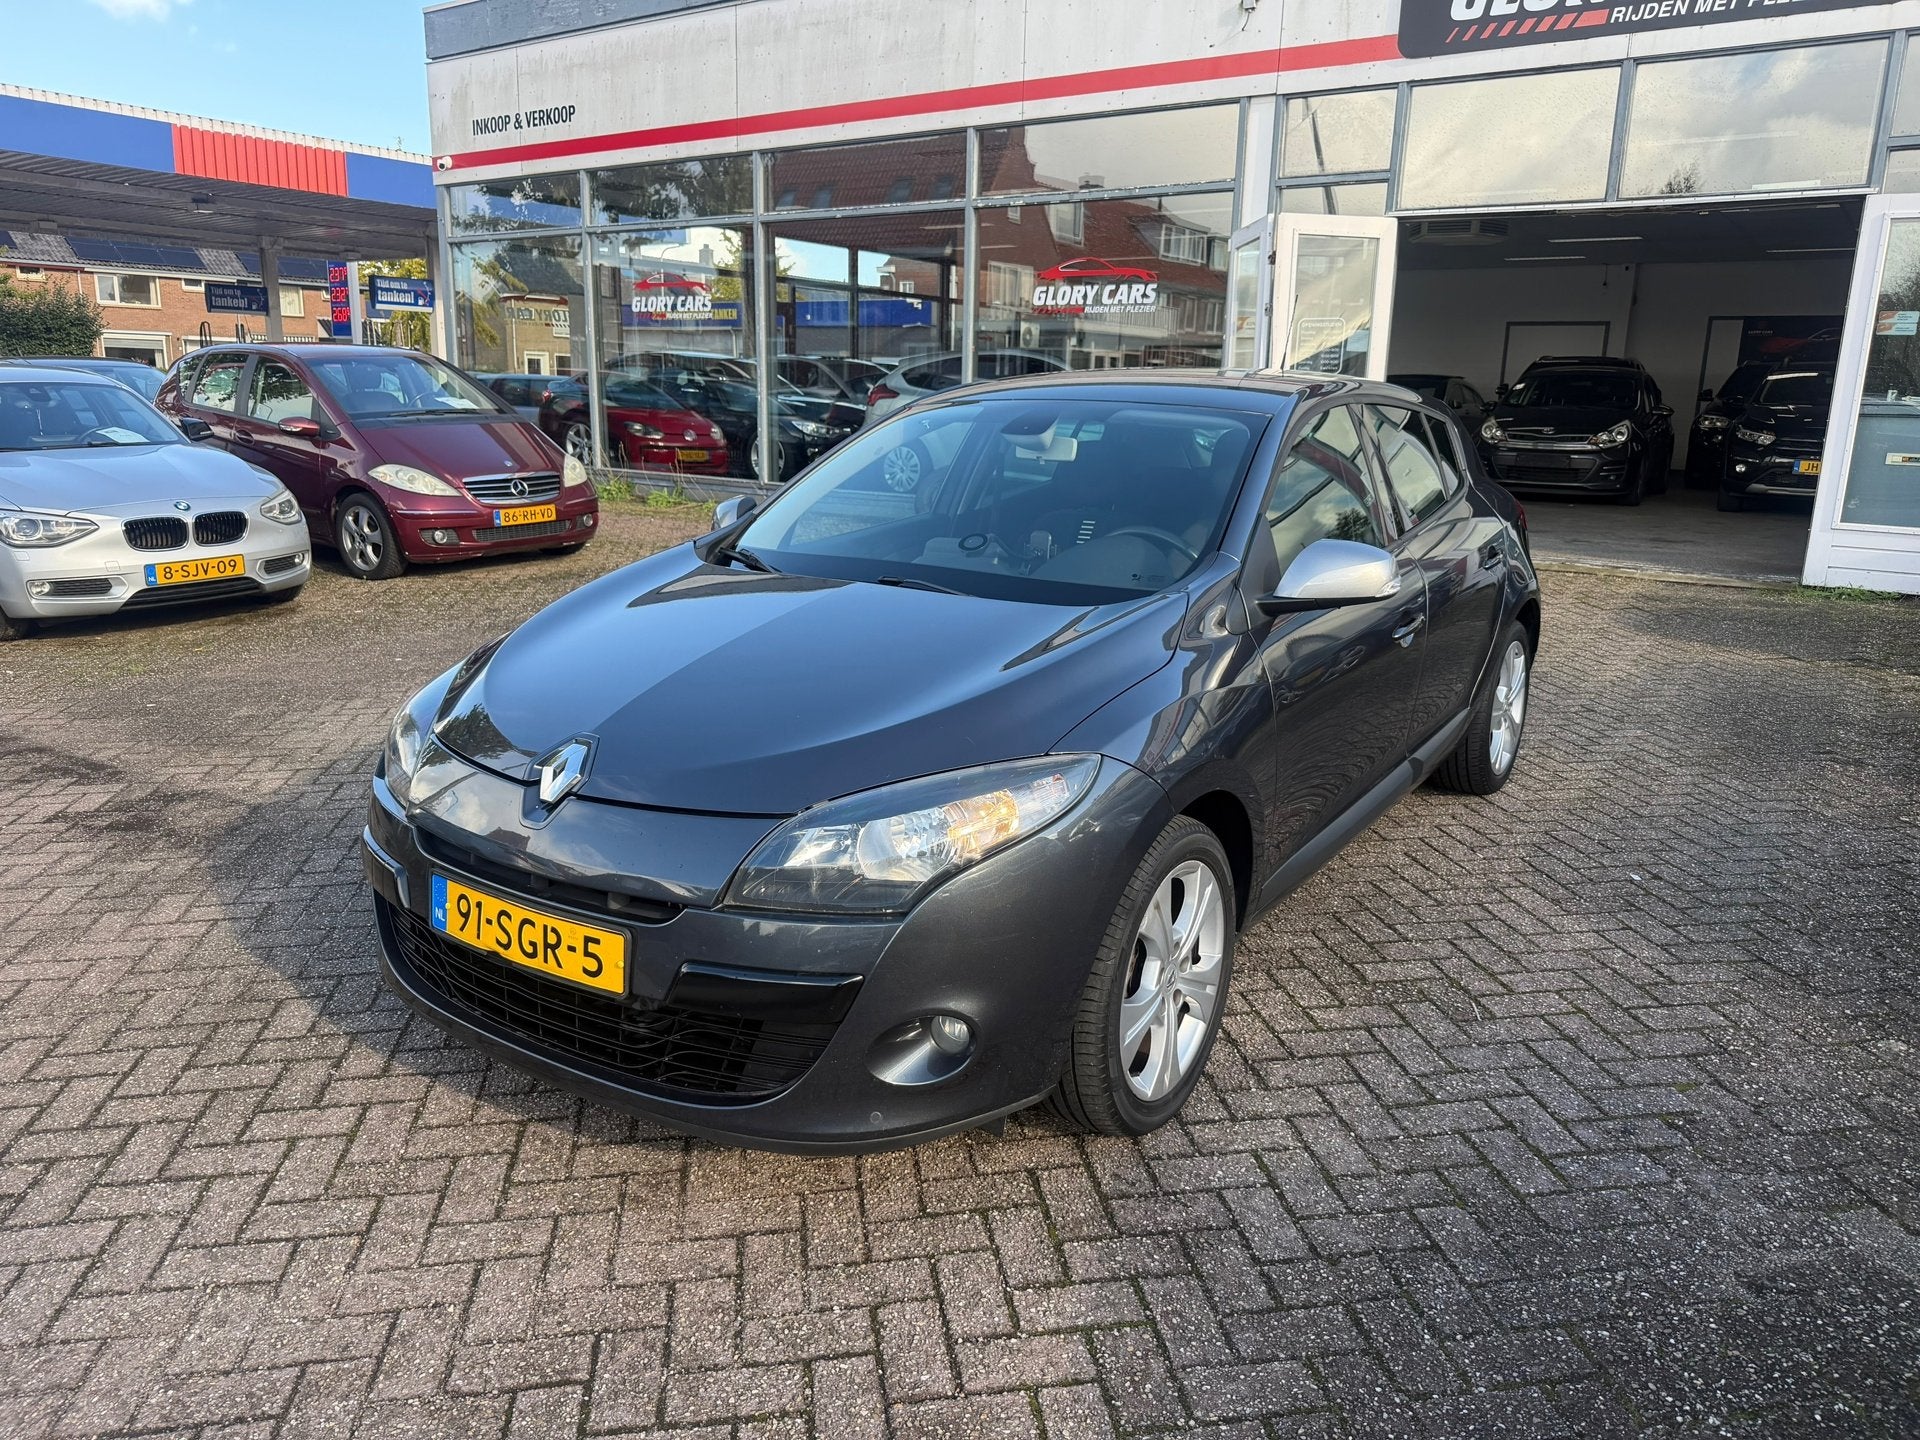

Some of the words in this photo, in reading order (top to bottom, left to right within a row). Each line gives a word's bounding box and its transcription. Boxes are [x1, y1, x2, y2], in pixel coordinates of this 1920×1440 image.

[1610, 0, 1687, 23] RIJDEN
[472, 114, 511, 136] INKOOP
[513, 112, 523, 130] &
[525, 104, 576, 128] VERKOOP
[377, 290, 414, 303] tanken!
[632, 296, 674, 312] GLORY
[676, 295, 712, 311] CARS
[1032, 284, 1099, 306] GLORY
[1101, 283, 1158, 305] CARS
[1126, 305, 1157, 313] PLEZIER
[503, 508, 553, 523] 86-RH-VD
[163, 559, 237, 580] 8-SJV-09
[435, 906, 445, 922] NL
[457, 893, 604, 978] 91-SGR-5
